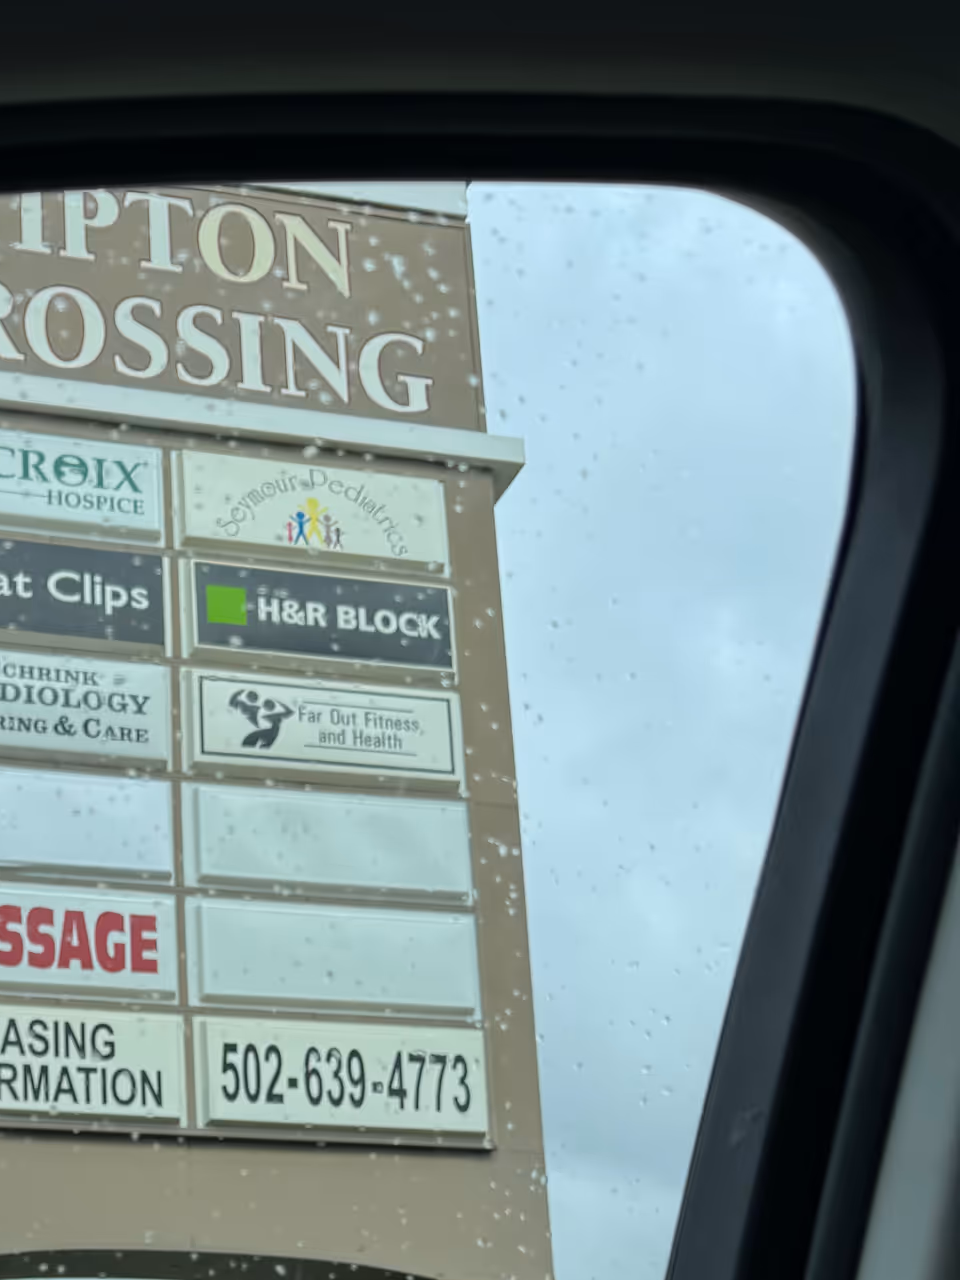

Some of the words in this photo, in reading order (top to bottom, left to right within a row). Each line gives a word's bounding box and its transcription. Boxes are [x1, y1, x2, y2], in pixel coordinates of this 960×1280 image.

[46, 489, 145, 516] HOSPICE
[216, 474, 298, 537] Seymour
[306, 468, 408, 557] Pediatrics
[46, 570, 150, 615] Clips
[256, 596, 327, 628] H&R
[336, 604, 441, 639] BLOCK
[53, 716, 77, 737] &
[83, 718, 150, 744] CARE
[298, 706, 322, 723] Far
[330, 708, 356, 726] Out
[319, 730, 345, 745] and
[352, 730, 403, 749] Health
[221, 1043, 471, 1113] 502-639-4773
